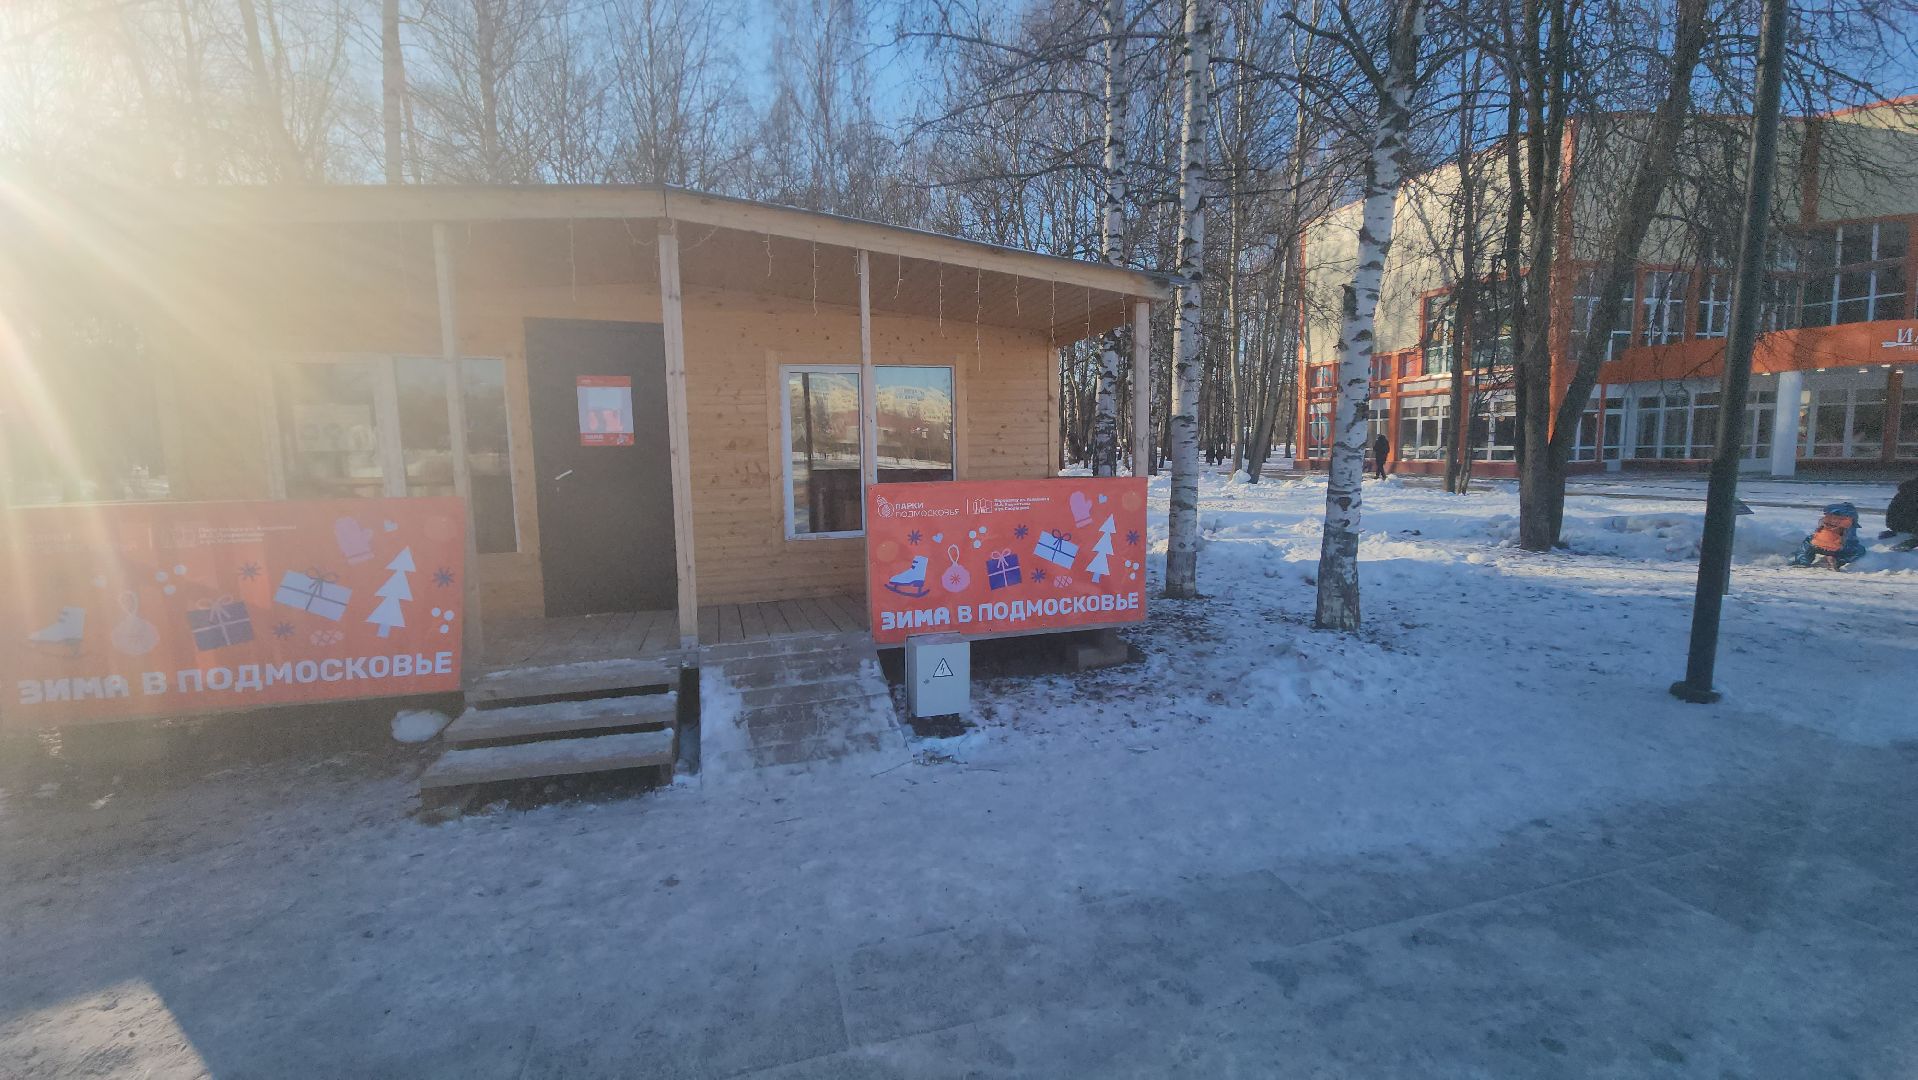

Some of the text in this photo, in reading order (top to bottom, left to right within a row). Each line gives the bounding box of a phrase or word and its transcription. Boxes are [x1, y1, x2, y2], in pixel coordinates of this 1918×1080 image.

[1897, 327, 1918, 343] И
[895, 502, 924, 511] ПАРКИ
[895, 509, 961, 518] ПОДМОСКОВЬЯ
[880, 592, 1139, 630] ЗИМА В ПОДМОСКОВЬЕ
[17, 651, 454, 705] ЗИМА В ПОДМОСКОВЬЕ
